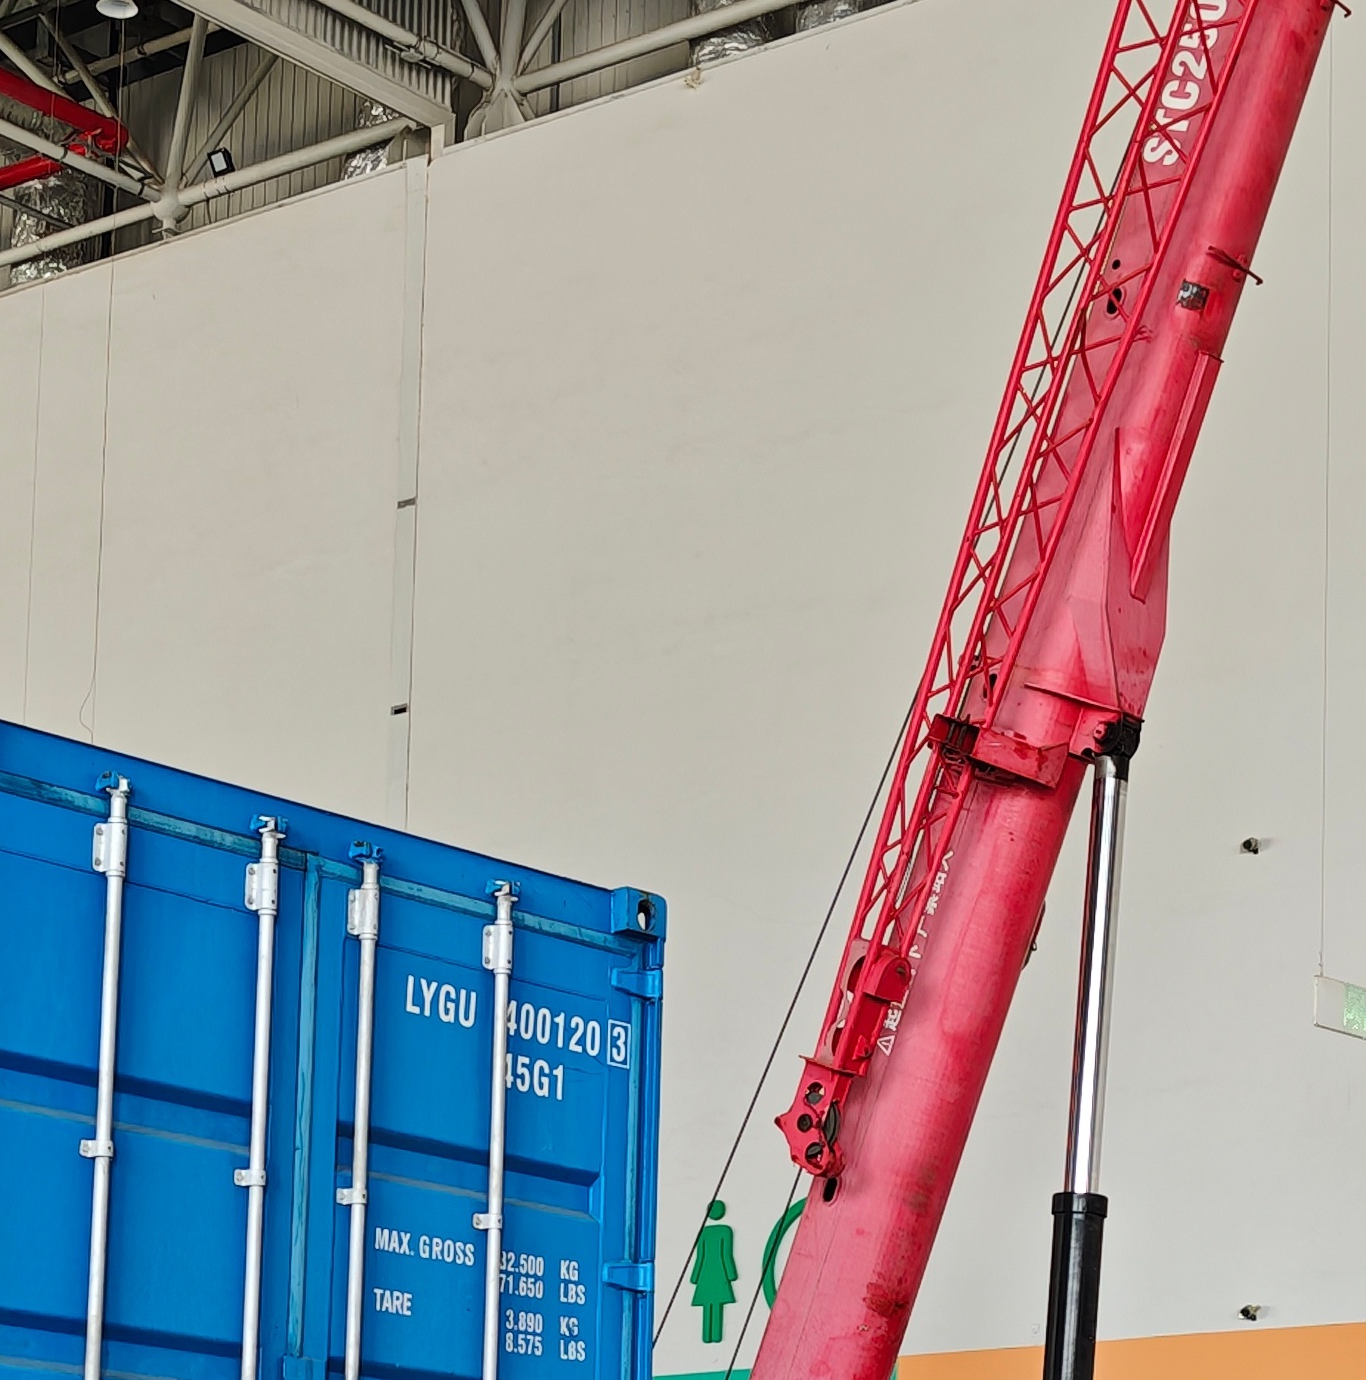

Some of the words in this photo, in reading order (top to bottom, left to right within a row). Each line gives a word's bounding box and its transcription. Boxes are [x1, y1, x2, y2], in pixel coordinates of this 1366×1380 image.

[405, 974, 477, 1028] LYGU
[506, 1000, 601, 1057] 400120
[375, 1227, 414, 1256] MAX.
[419, 1235, 475, 1266] GROSS
[560, 1260, 579, 1281] KG
[374, 1288, 412, 1316] TARE
[505, 1309, 543, 1334] 3.890
[560, 1316, 579, 1336] KG
[498, 1274, 544, 1299] 71.650
[560, 1284, 585, 1305] LBS
[505, 1332, 543, 1356] 8.575
[560, 1340, 585, 1362] LBS
